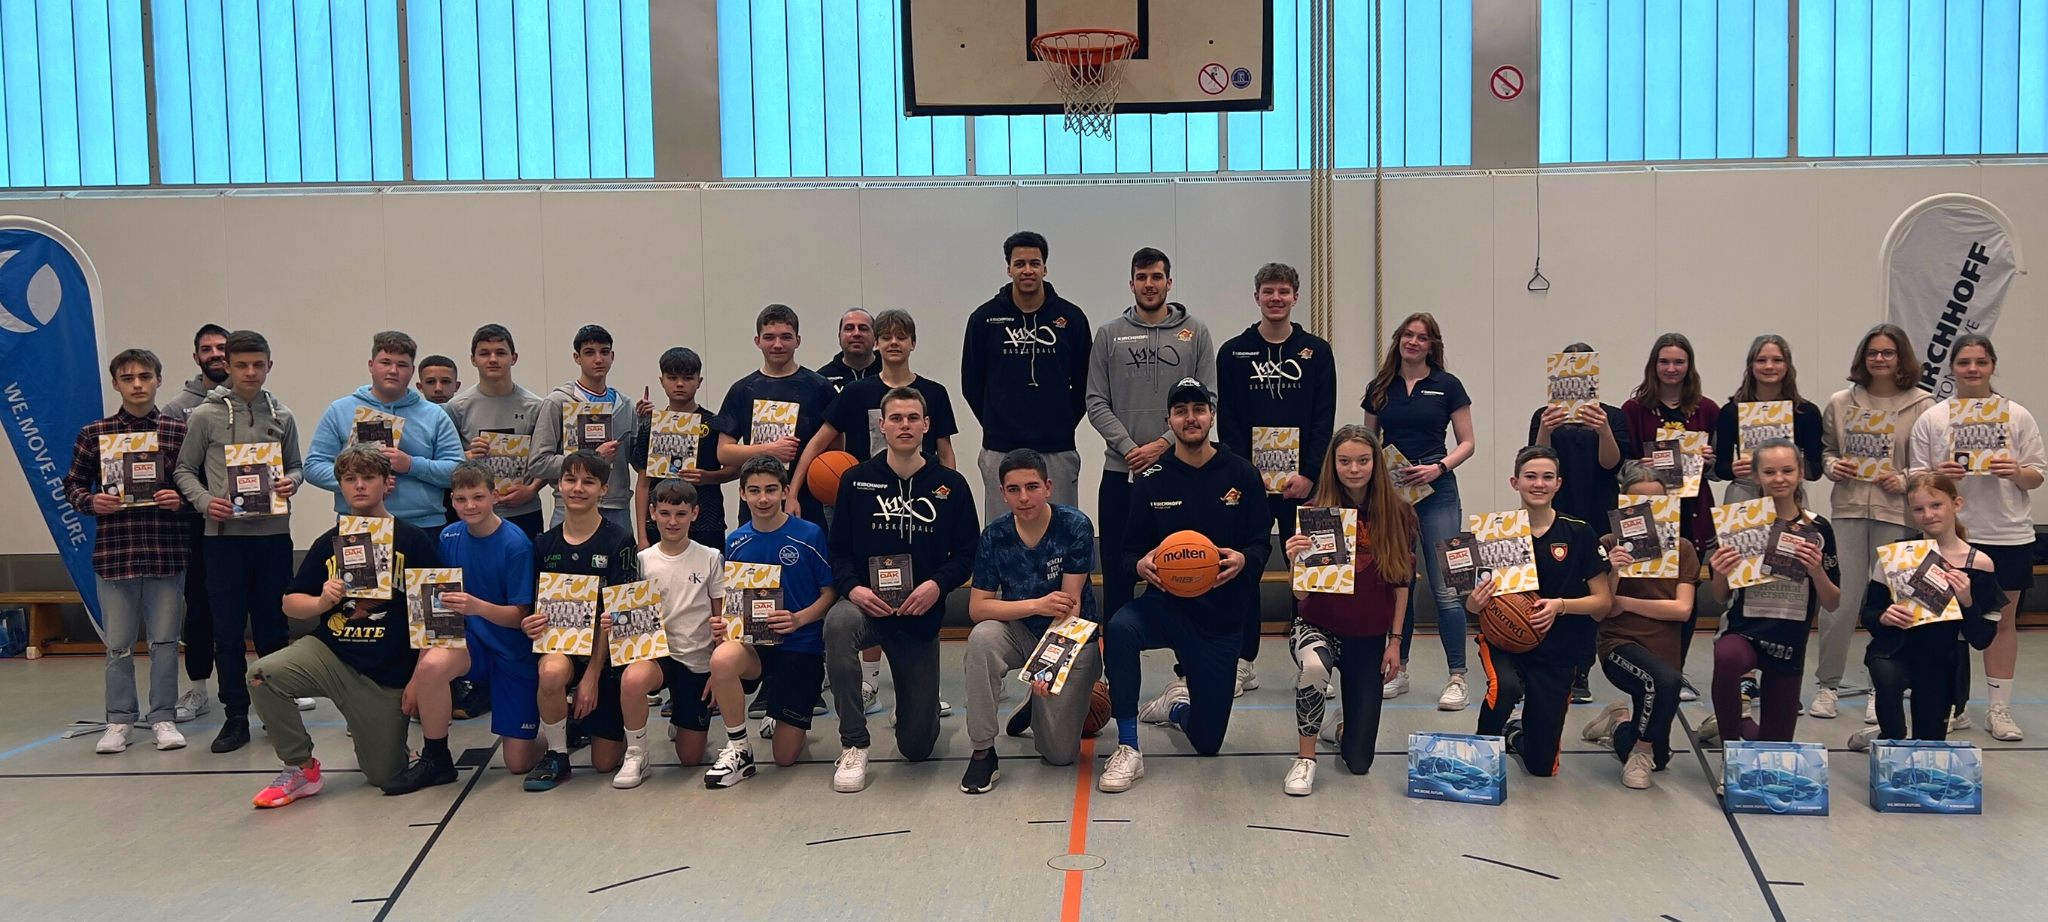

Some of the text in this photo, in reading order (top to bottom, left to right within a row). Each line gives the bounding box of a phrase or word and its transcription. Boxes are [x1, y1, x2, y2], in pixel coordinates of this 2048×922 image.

[1915, 242, 1991, 394] IRCHHOFF
[1163, 548, 1206, 563] molten
[1753, 590, 1805, 602] versorger
[1488, 602, 1527, 638] SPALDING
[332, 626, 386, 638] STATE
